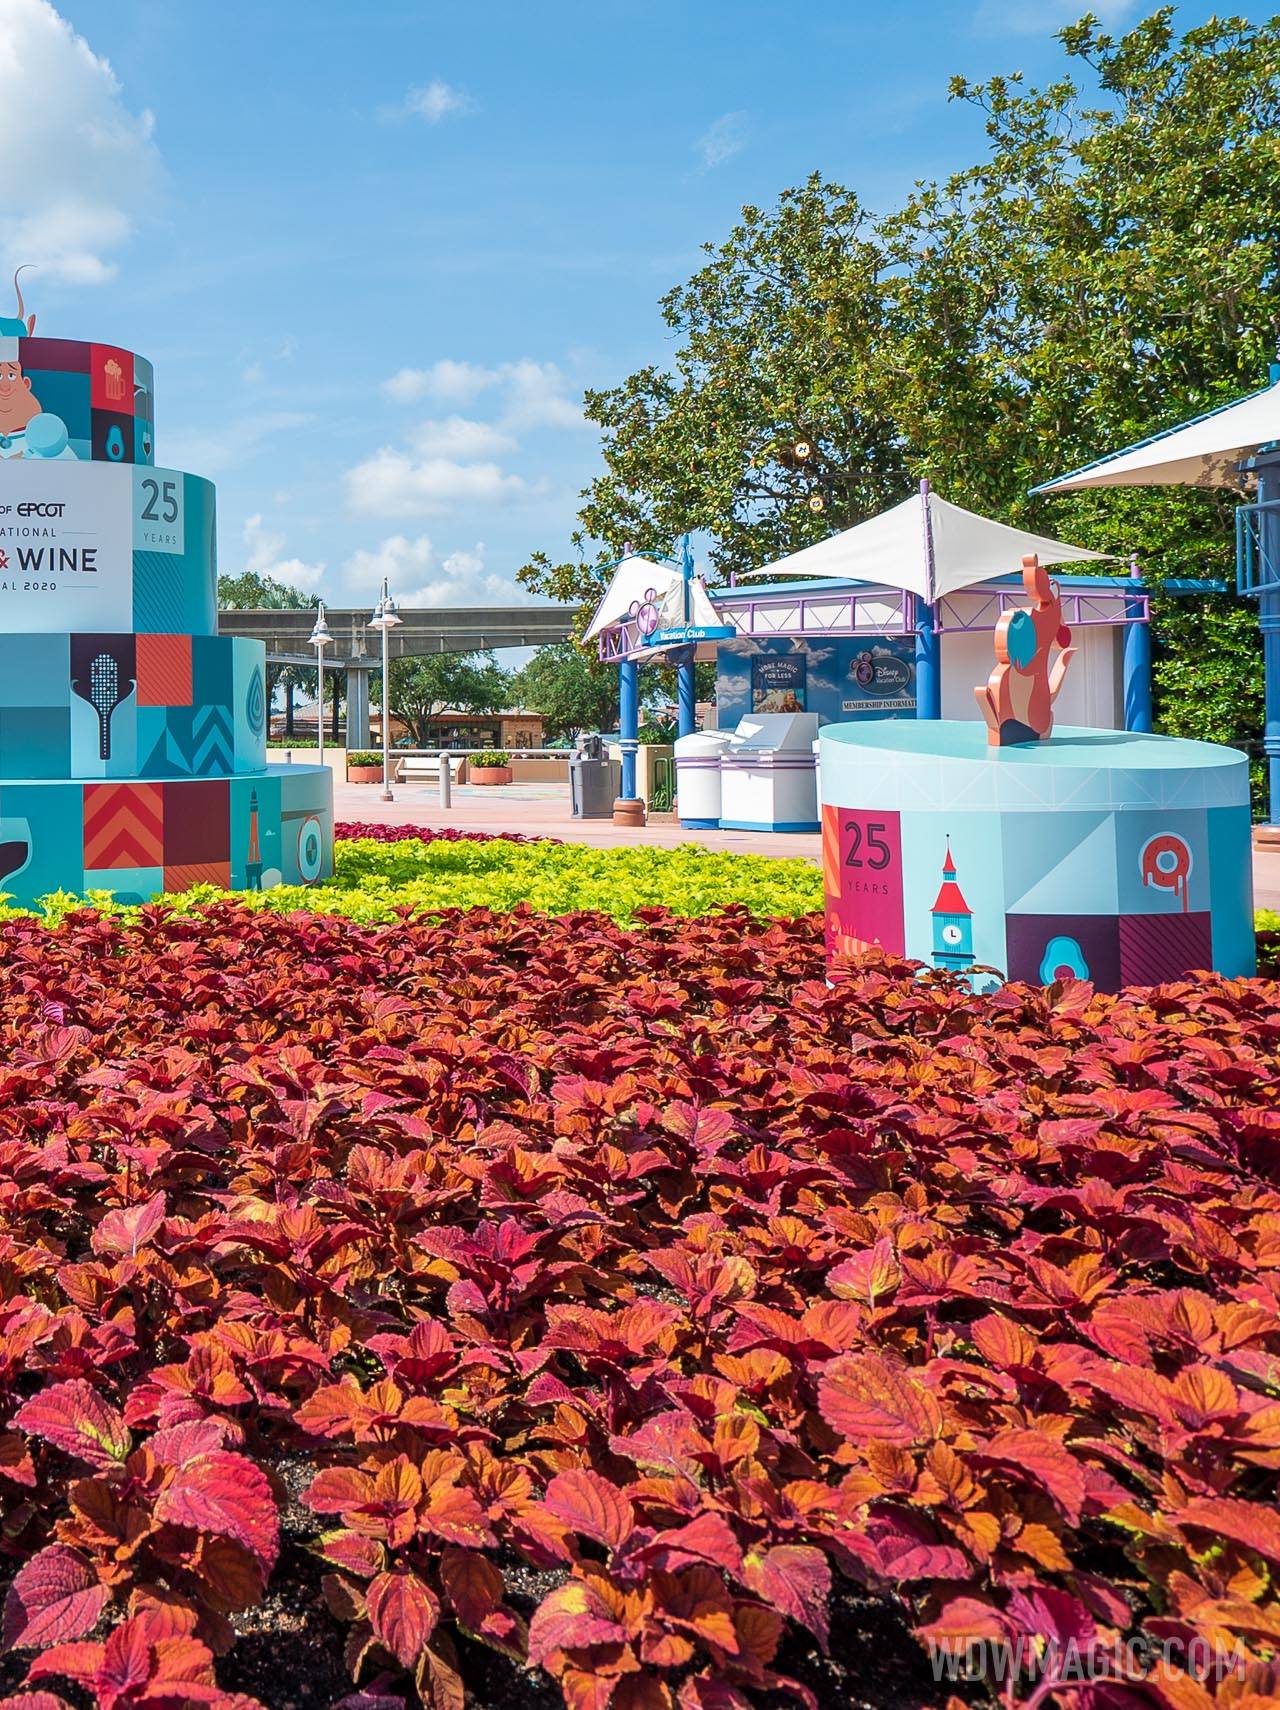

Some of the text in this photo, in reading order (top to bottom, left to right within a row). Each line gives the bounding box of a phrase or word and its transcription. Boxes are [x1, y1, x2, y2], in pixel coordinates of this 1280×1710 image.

[141, 478, 178, 523] 25
[17, 503, 66, 518] EPCOT
[143, 532, 177, 545] YEARS
[16, 547, 98, 572] WINE
[23, 582, 57, 591] 2020
[687, 629, 705, 638] Club
[875, 666, 899, 679] Disney
[843, 699, 917, 710] MEMBERSHIP INFORMAT
[844, 821, 891, 870] 25
[848, 881, 888, 895] YEARS
